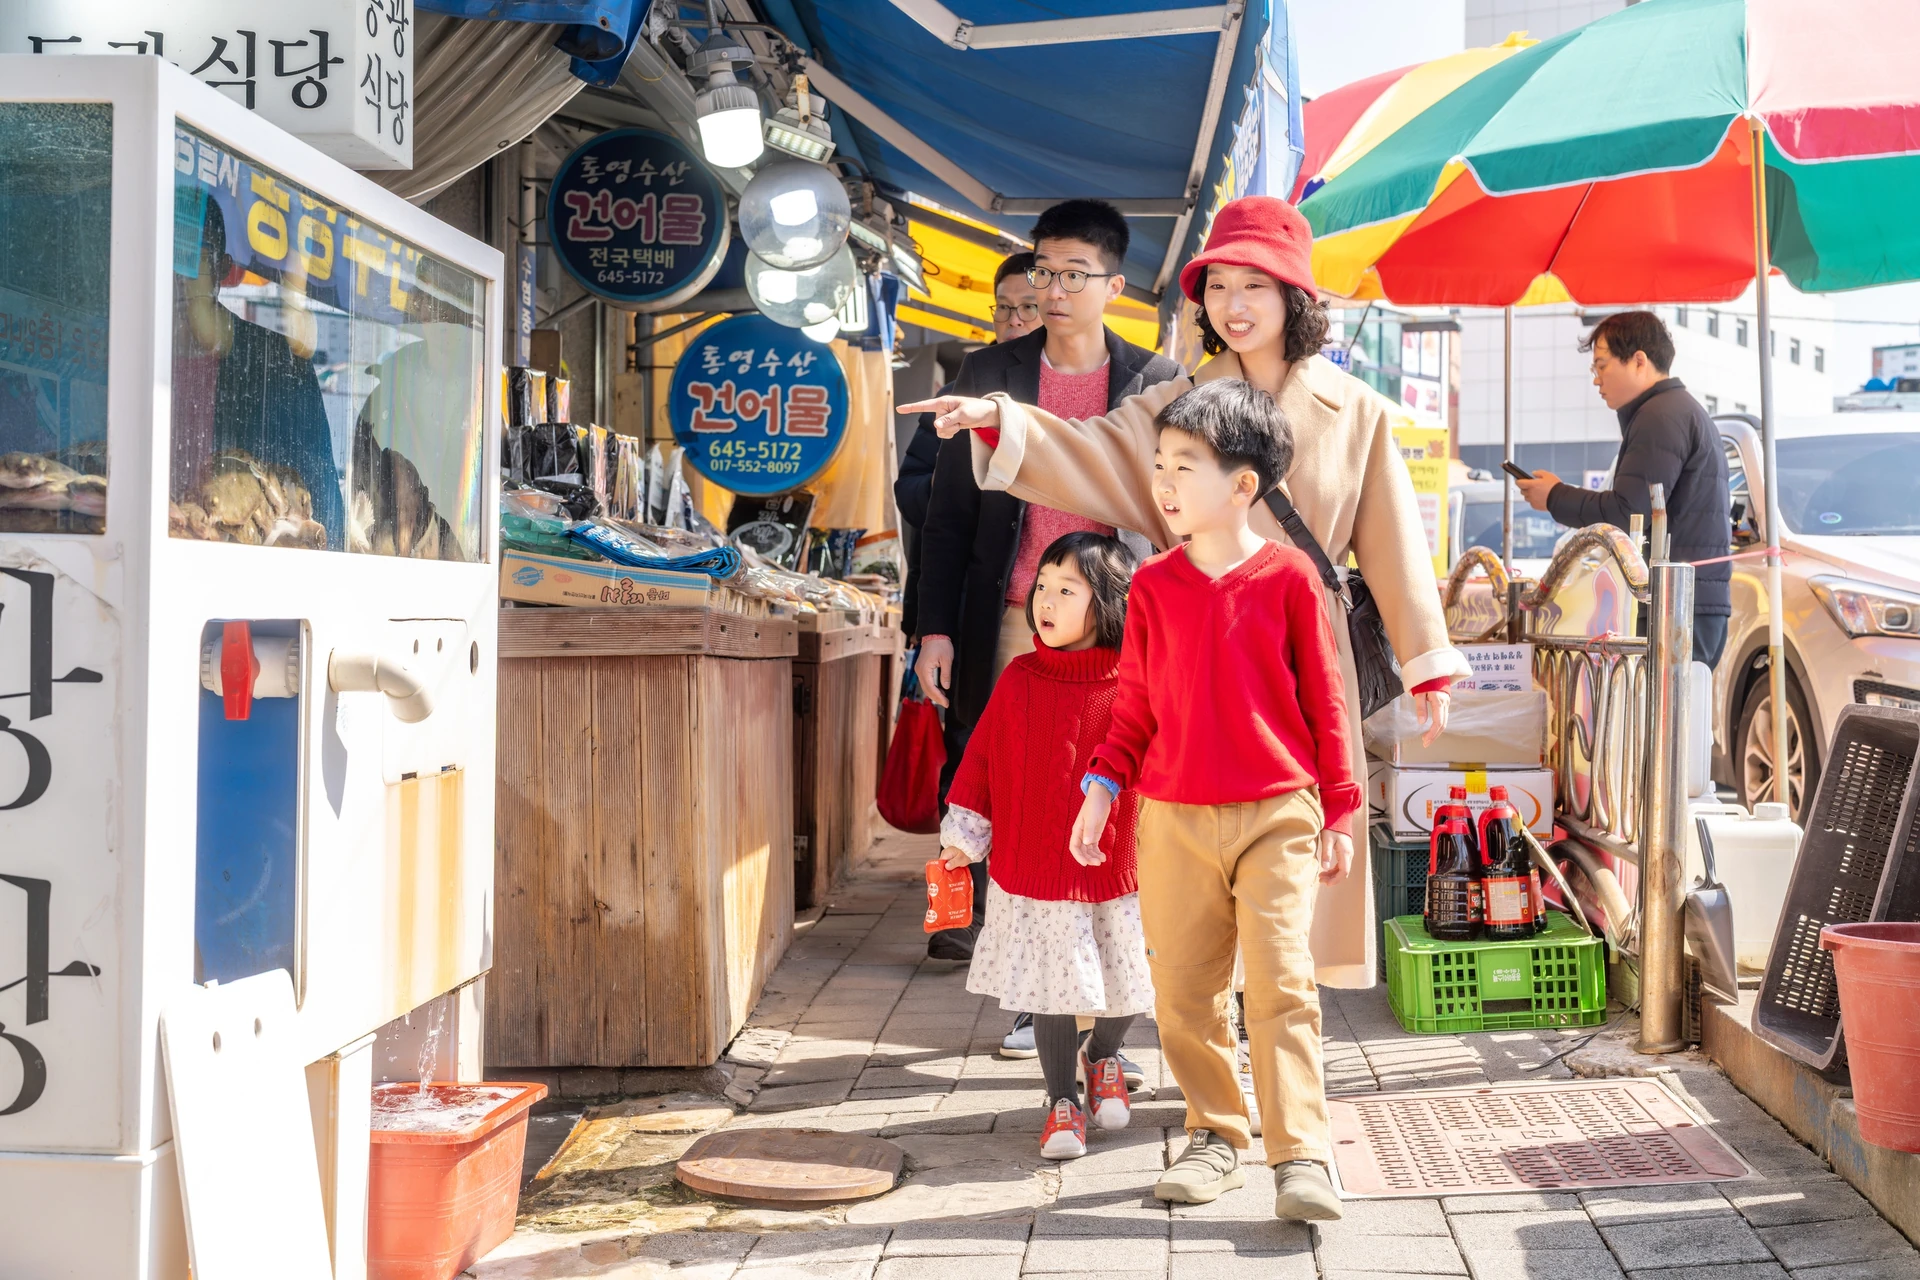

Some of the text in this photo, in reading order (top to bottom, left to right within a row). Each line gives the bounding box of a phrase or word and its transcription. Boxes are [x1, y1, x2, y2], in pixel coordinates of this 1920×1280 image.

[360, 53, 409, 146] 식당
[580, 156, 692, 185] 통영수산
[563, 188, 707, 246] 건어물
[588, 248, 675, 270] 전국택배
[597, 270, 664, 285] 645-5172
[701, 346, 819, 376] 통영수산
[687, 380, 832, 438] 건어물
[708, 440, 802, 462] 645-5172
[709, 459, 800, 475] 017-552-8097
[600, 577, 645, 605] 멸치
[647, 587, 670, 601] 마른
